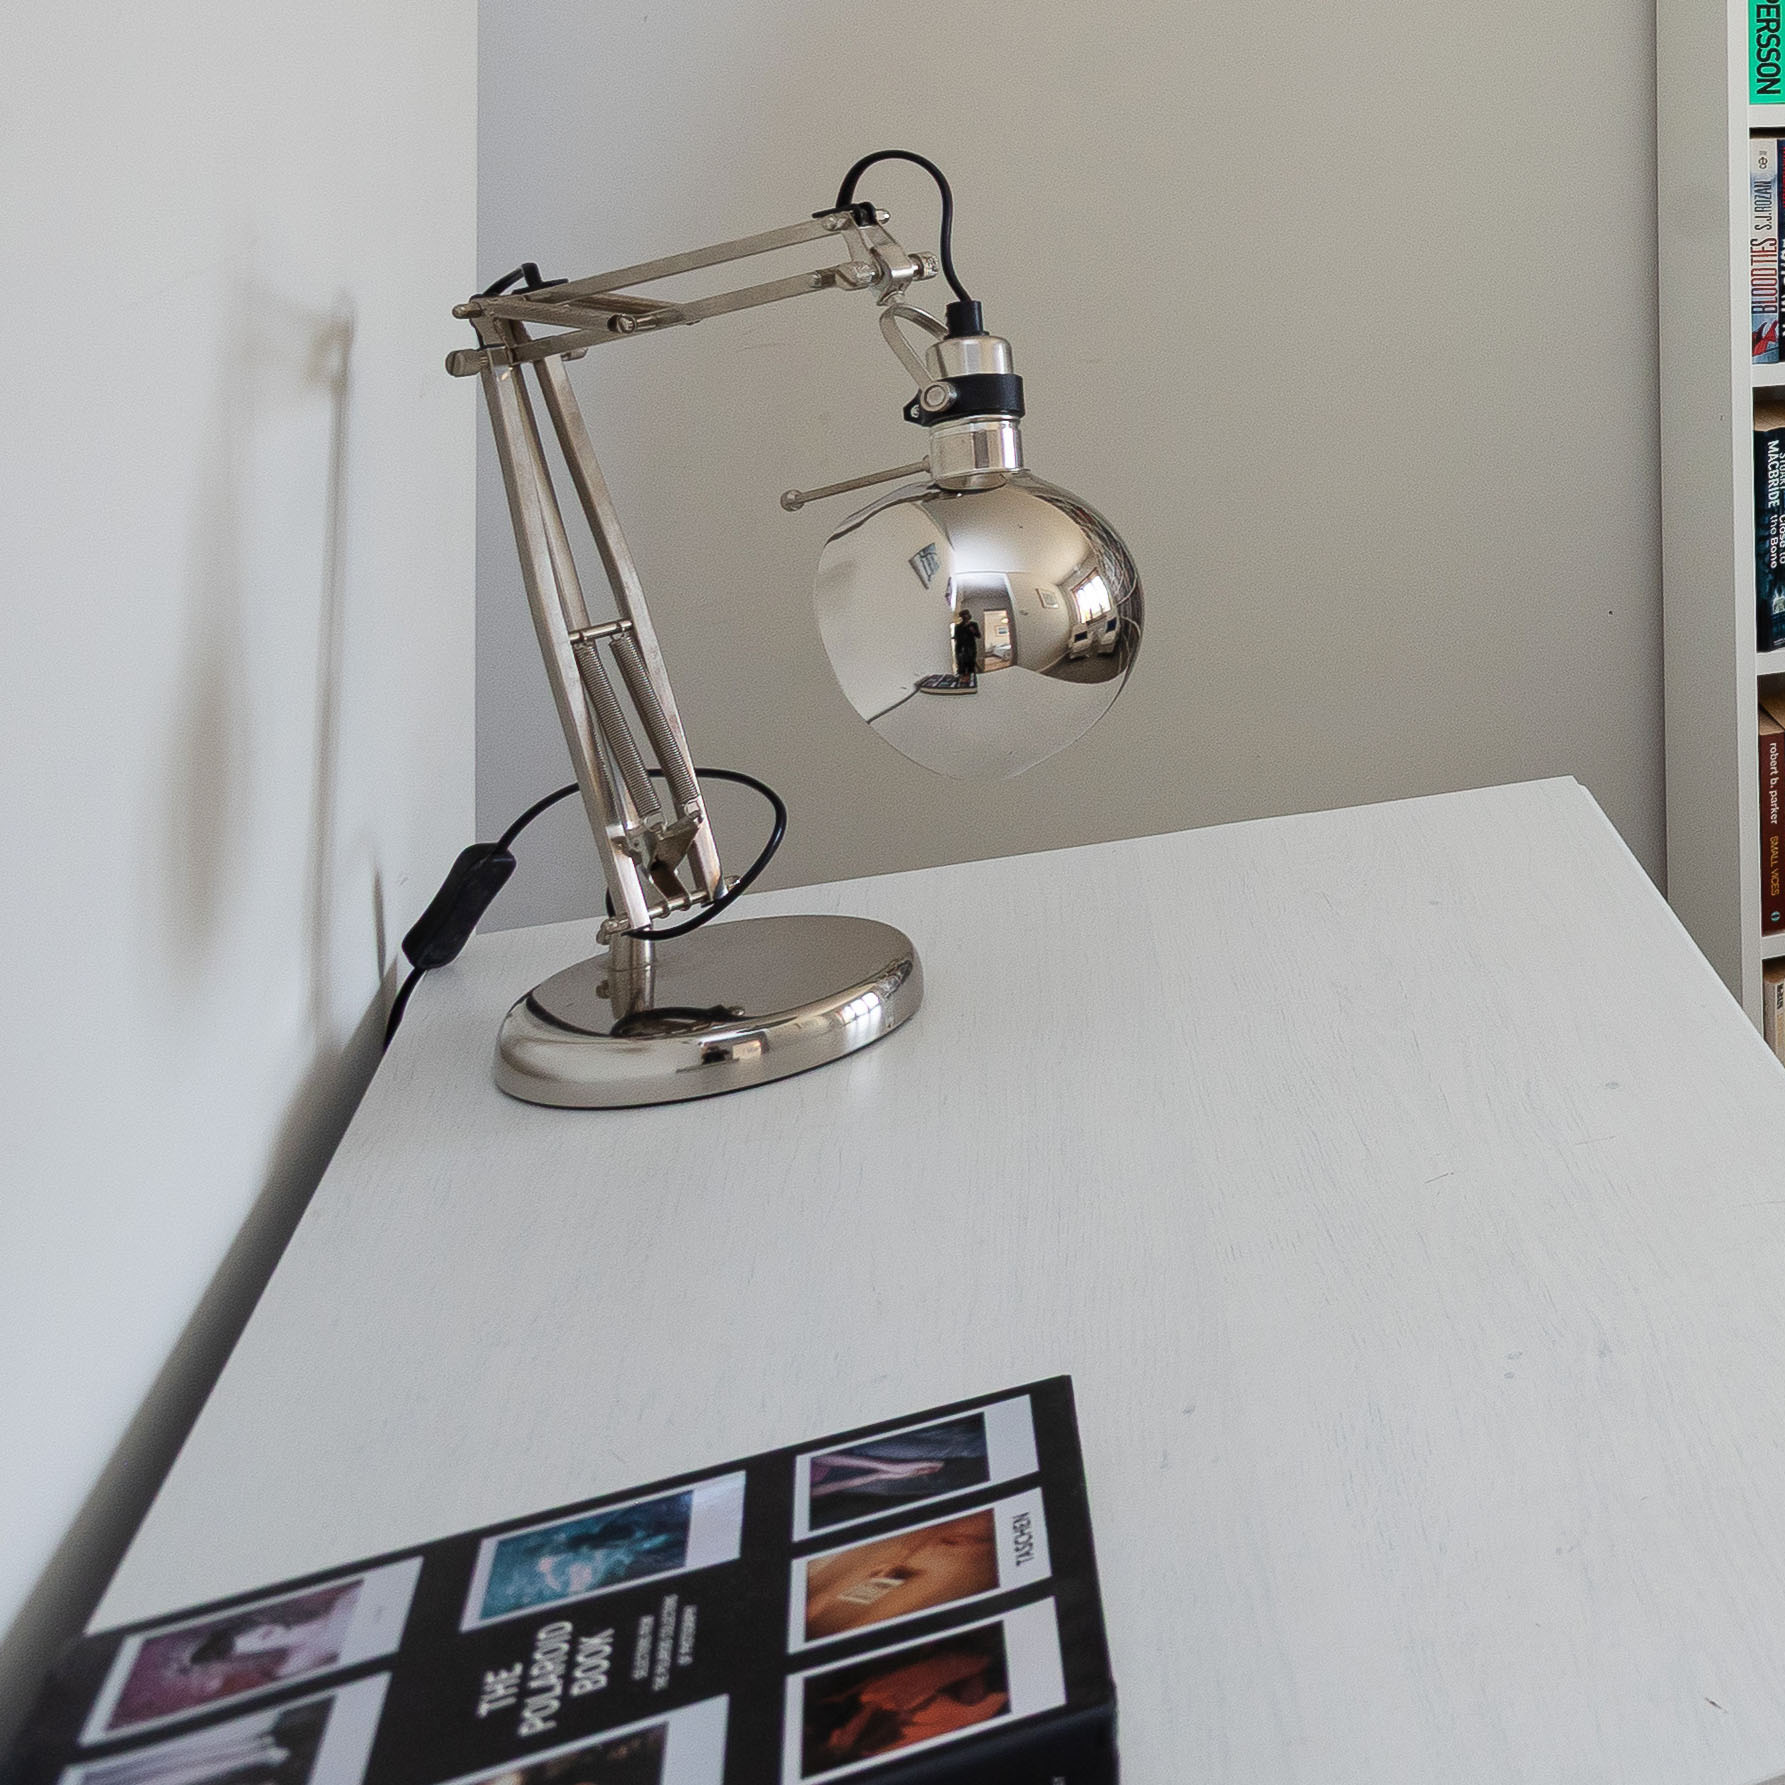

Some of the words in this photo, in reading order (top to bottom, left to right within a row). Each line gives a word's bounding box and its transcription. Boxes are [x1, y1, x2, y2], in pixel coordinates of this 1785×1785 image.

[1013, 1511, 1032, 1568] TASCHEN
[478, 1662, 523, 1717] THE
[516, 1621, 573, 1736] POLAROID
[569, 1628, 615, 1696] BOOK
